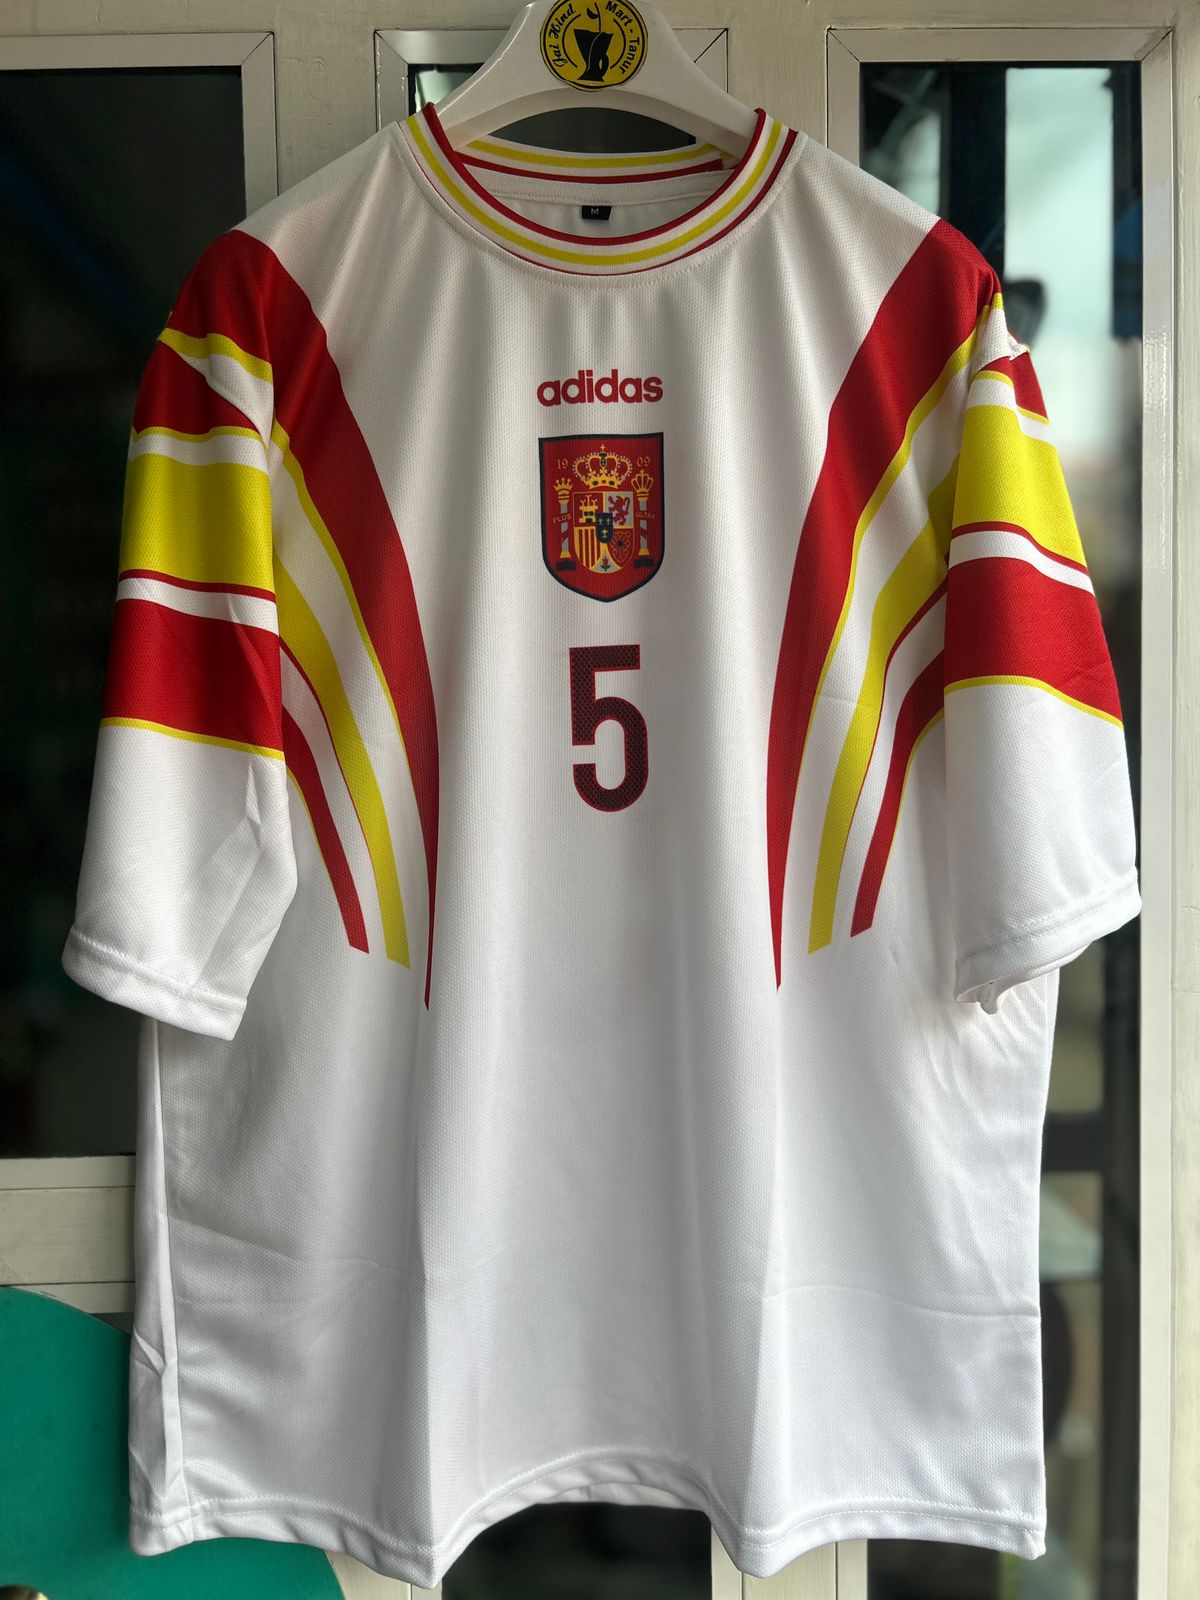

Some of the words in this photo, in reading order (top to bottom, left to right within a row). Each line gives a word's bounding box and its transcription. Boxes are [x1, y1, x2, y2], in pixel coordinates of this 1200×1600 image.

[605, 1, 632, 27] Mart
[618, 37, 641, 75] Tanur
[536, 368, 664, 407] adidas
[568, 643, 650, 813] 5
